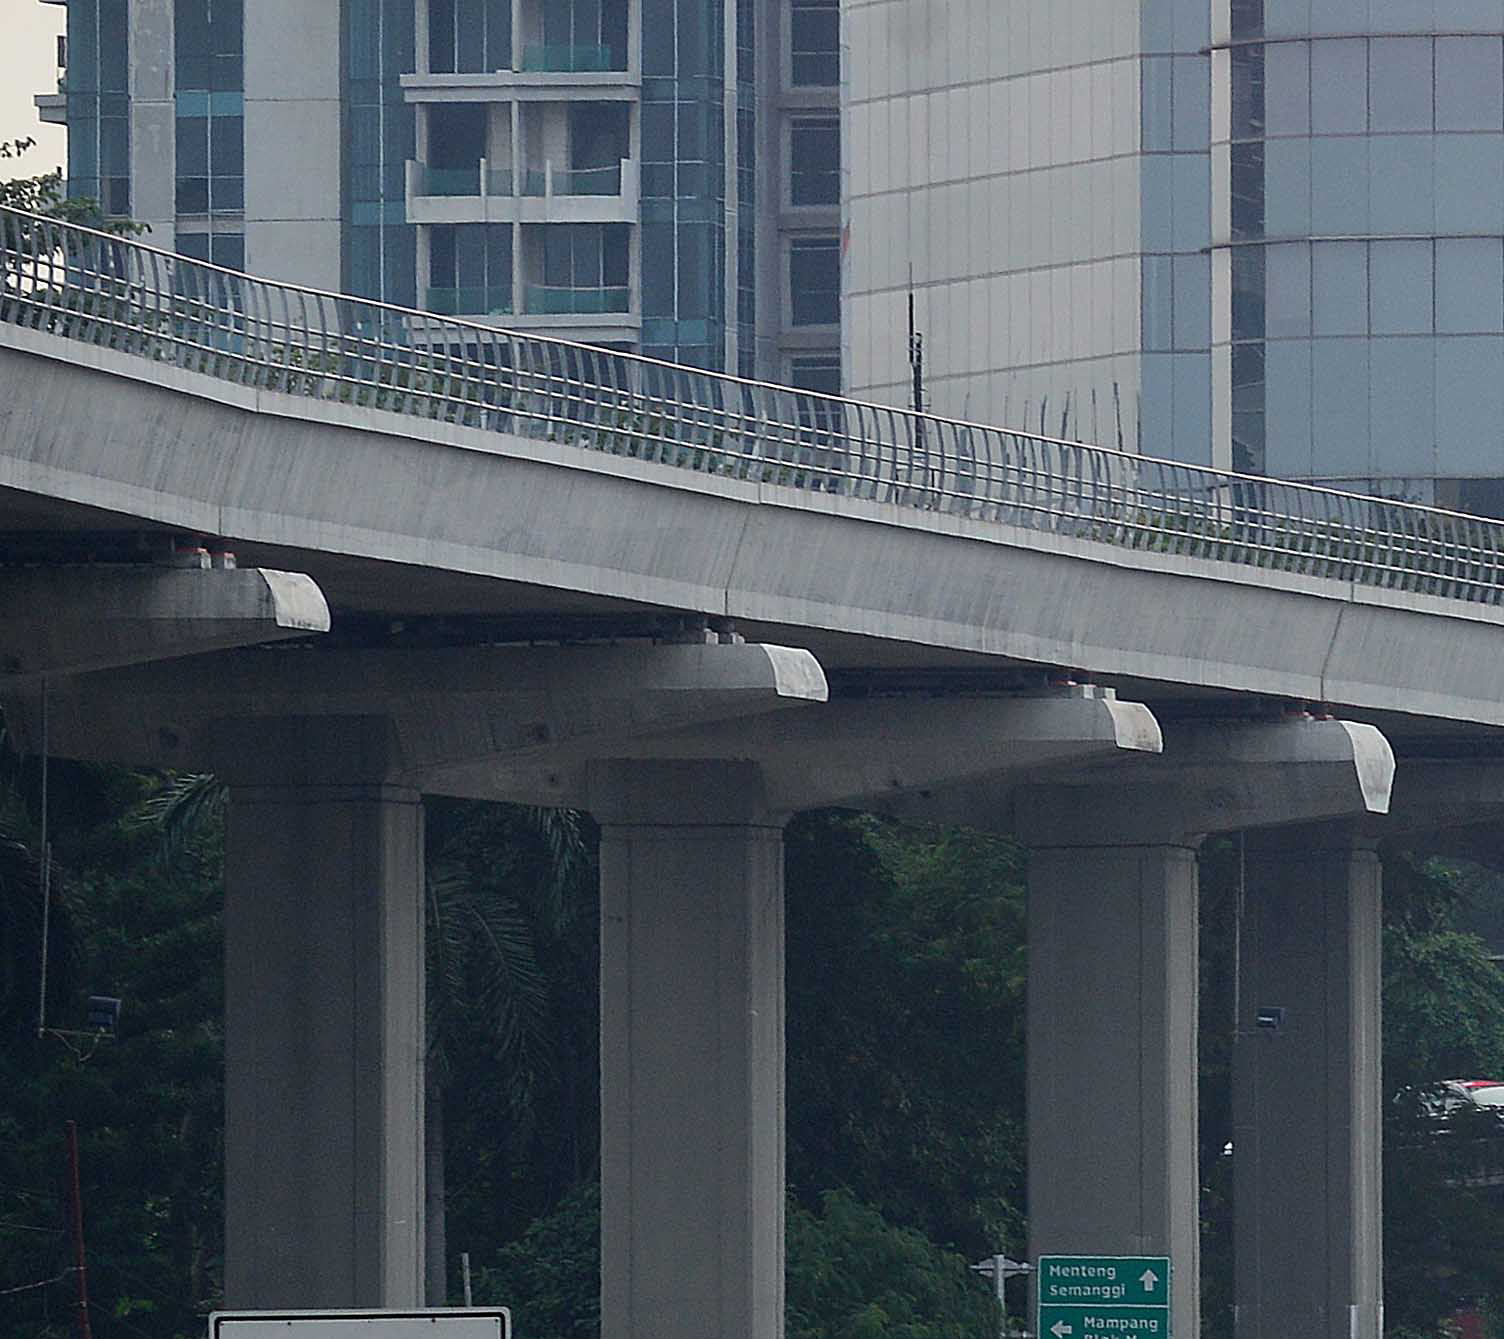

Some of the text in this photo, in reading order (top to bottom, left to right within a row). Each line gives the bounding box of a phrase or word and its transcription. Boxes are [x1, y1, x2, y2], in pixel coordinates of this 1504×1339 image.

[1049, 1265, 1116, 1281] Menteng
[1050, 1284, 1126, 1298] Semanggi
[1084, 1317, 1159, 1333] Mampang
